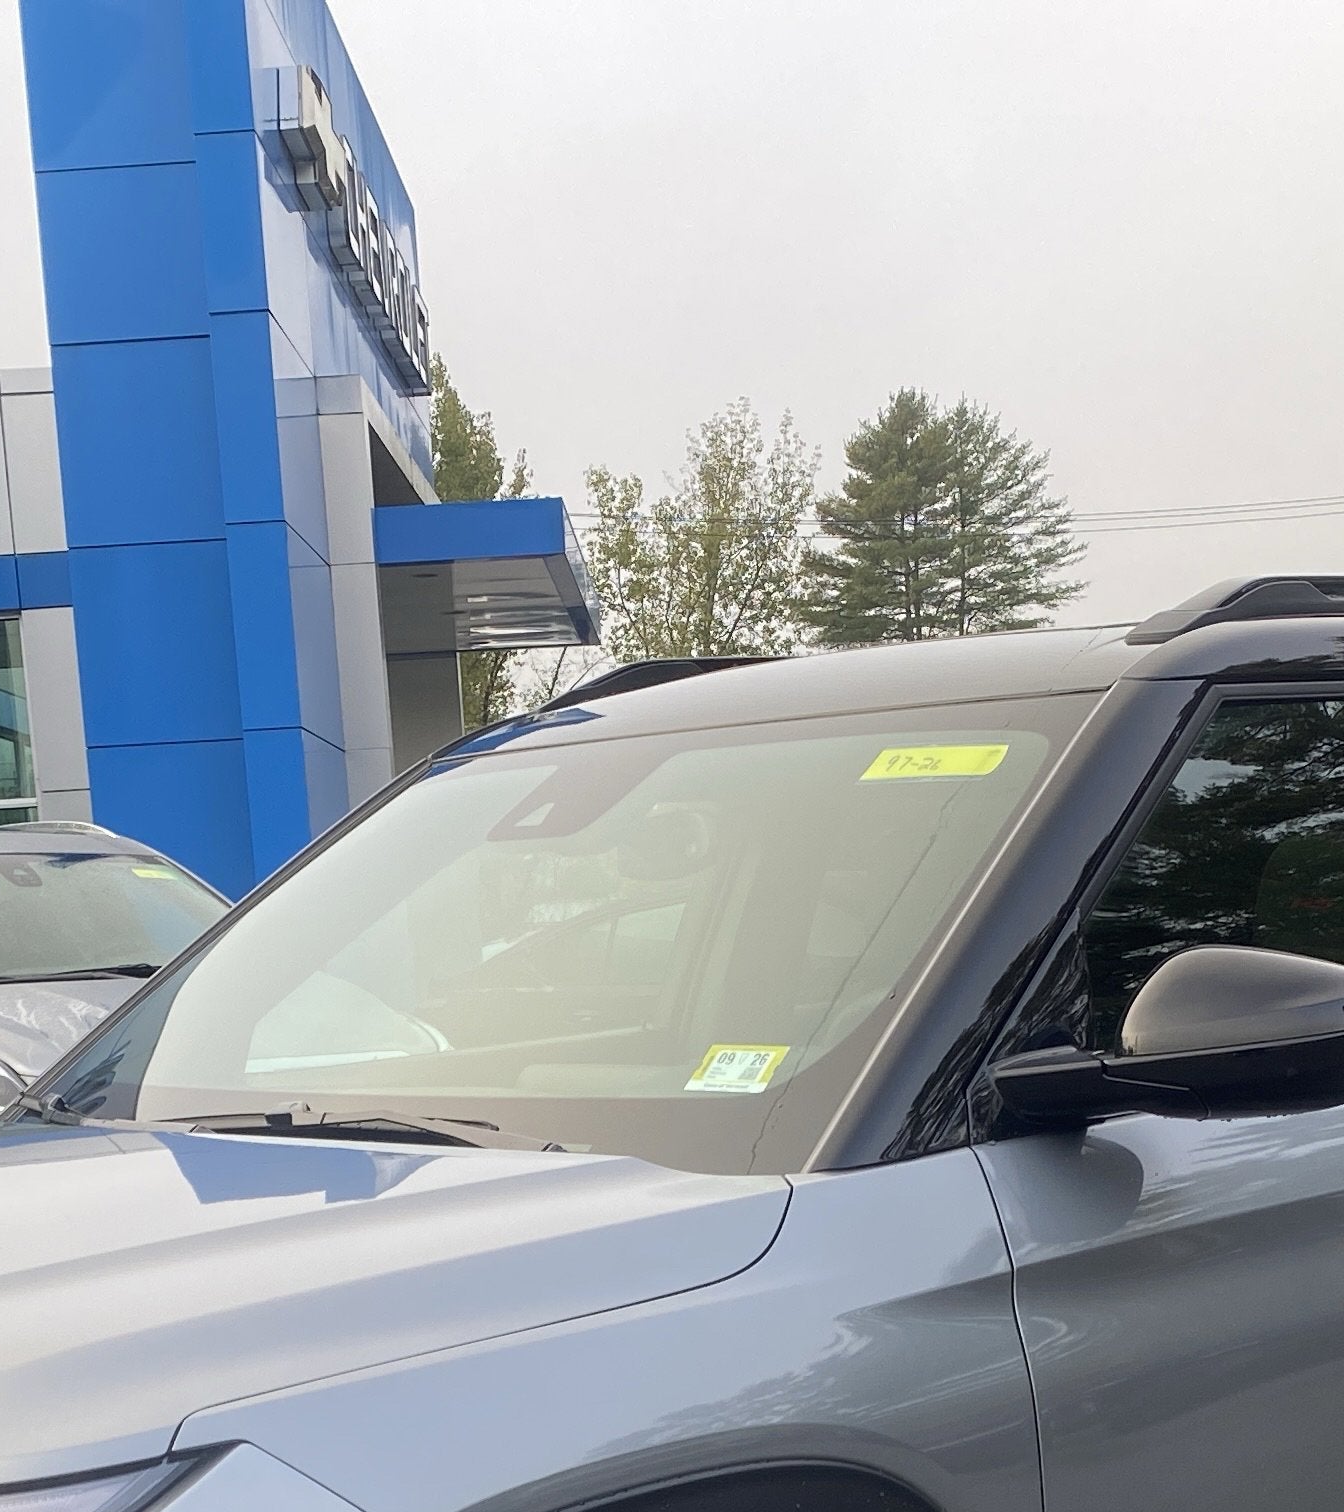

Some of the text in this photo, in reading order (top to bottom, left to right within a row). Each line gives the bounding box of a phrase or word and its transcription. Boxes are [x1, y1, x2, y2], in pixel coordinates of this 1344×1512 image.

[885, 755, 943, 772] 97-26
[716, 1051, 771, 1067] 09 26
